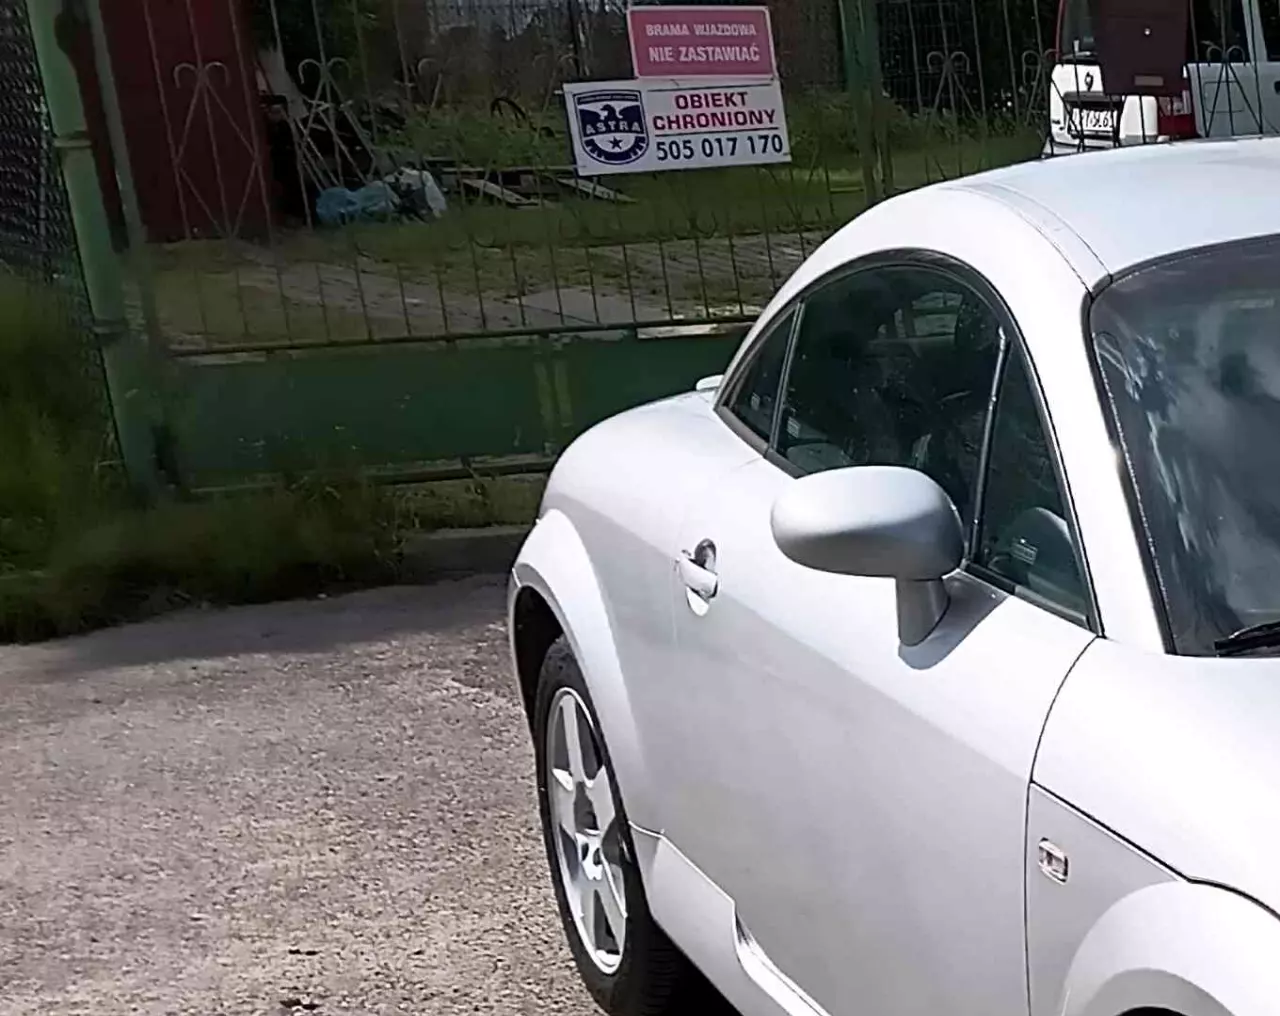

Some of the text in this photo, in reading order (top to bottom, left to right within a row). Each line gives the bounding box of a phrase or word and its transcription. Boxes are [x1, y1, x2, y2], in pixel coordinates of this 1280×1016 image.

[646, 24, 757, 37] BRAMA WJAZDOWA
[649, 44, 760, 62] NIE ZASTAWIAĆ
[675, 92, 747, 110] OBIEKT
[585, 120, 642, 135] ASTRA
[653, 110, 775, 130] CHRONIONY
[656, 134, 783, 161] 505 017 170
